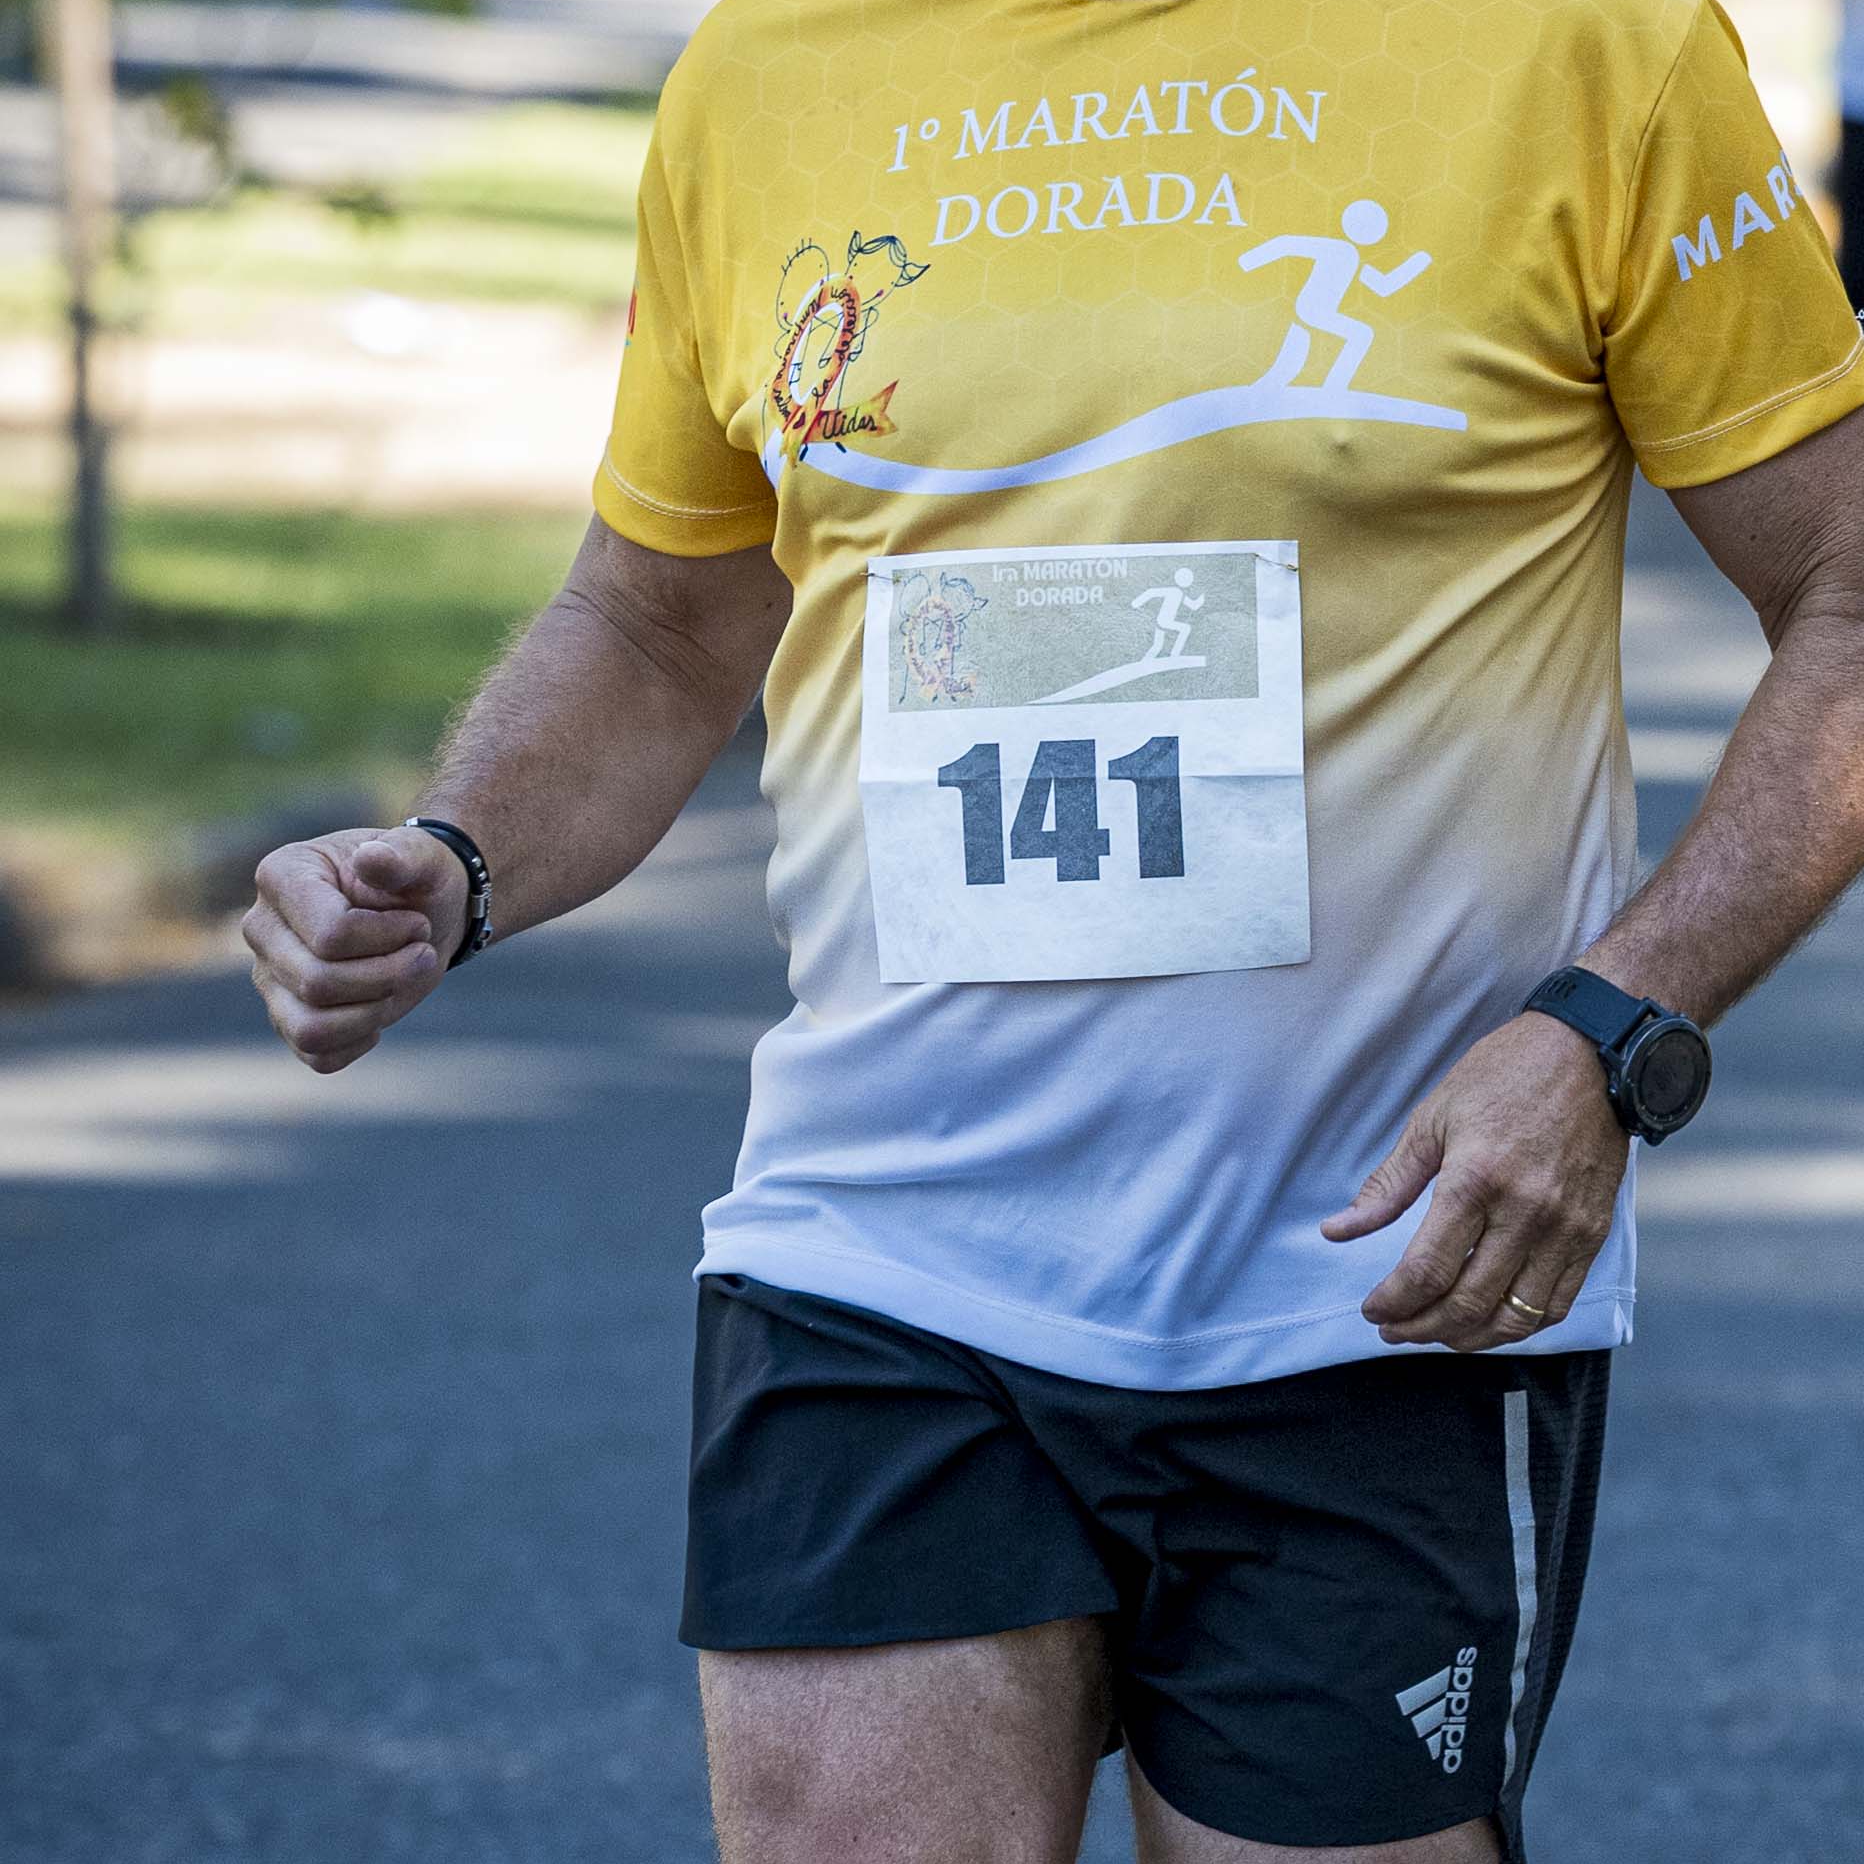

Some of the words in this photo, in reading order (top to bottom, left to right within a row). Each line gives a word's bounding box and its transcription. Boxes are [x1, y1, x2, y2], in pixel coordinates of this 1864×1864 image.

[952, 67, 1327, 159] MARATÓN
[929, 172, 1248, 248] DORADA
[1016, 586, 1104, 607] DORADA
[938, 736, 1185, 885] 141
[1442, 1646, 1478, 1774] adidas
